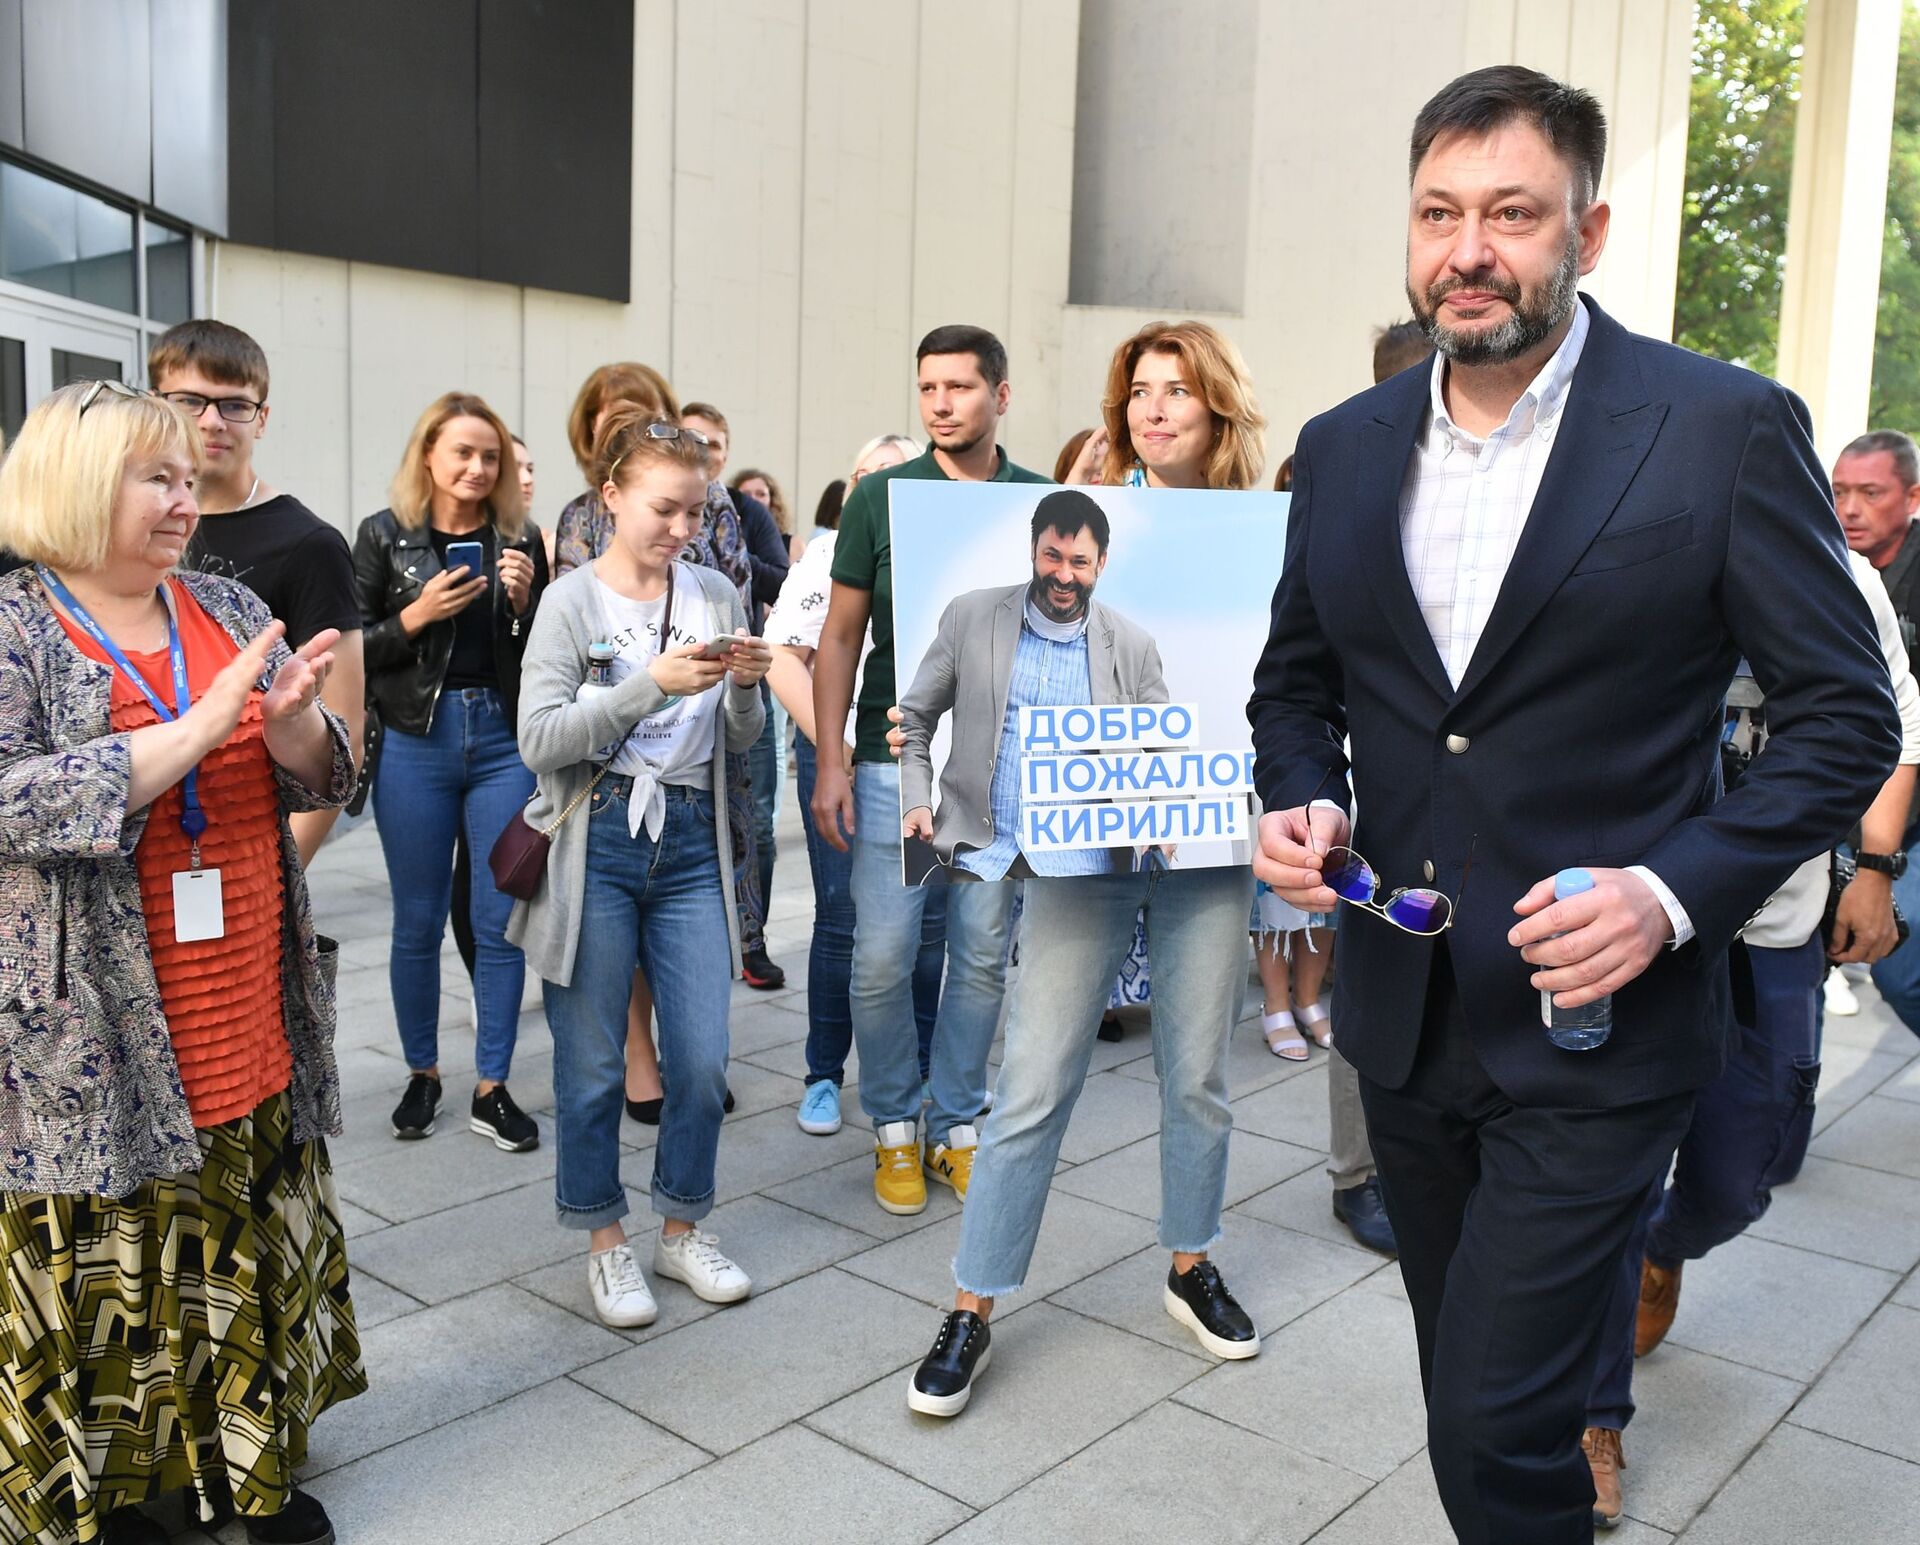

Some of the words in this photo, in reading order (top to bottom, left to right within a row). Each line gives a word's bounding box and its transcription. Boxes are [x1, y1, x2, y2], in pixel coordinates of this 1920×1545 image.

[643, 732, 672, 740] BELIEVE
[1024, 705, 1192, 750] ДОБРО
[1031, 801, 1236, 845] КИРИЛЛ!
[938, 1158, 954, 1178] N
